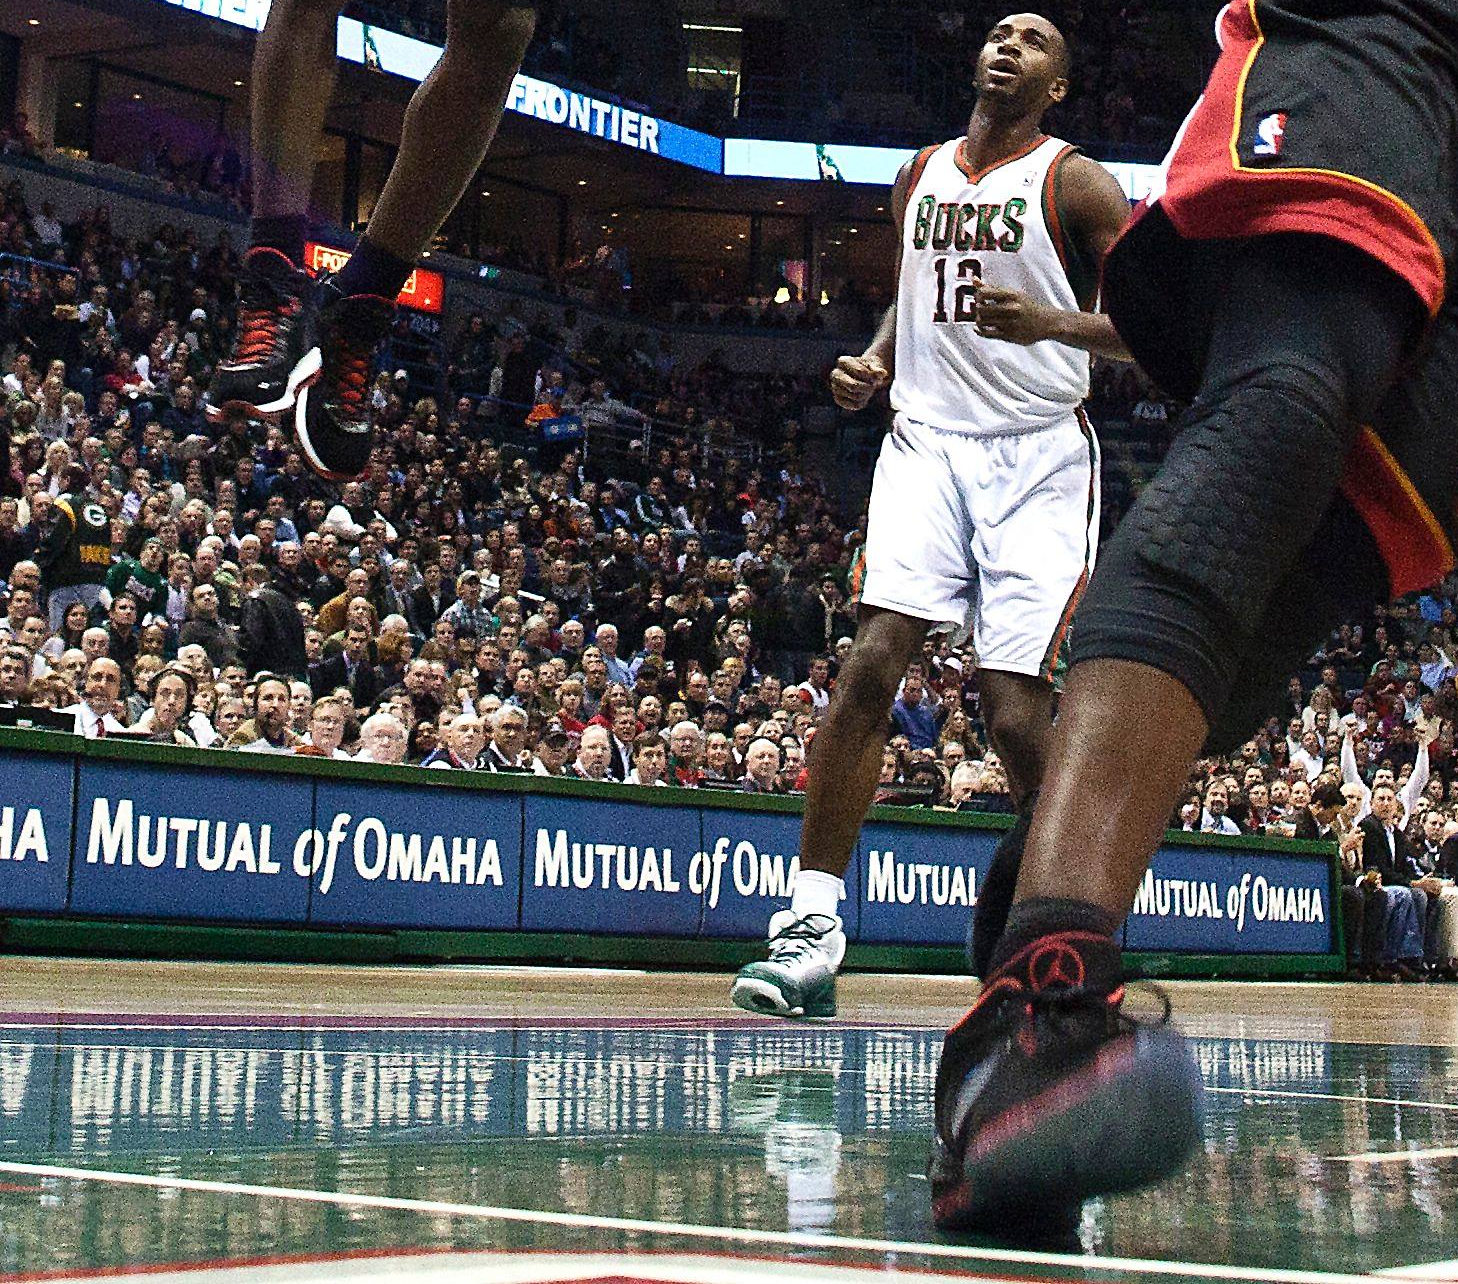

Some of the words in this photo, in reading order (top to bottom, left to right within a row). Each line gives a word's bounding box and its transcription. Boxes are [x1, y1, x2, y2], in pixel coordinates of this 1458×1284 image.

[505, 73, 660, 154] FRONTIER
[912, 193, 1028, 254] BUCKS
[931, 257, 984, 324] 12
[87, 797, 281, 874] MUTUAL
[293, 813, 351, 895] of
[353, 817, 503, 886] OMAHA
[533, 828, 680, 893] MUTUAL
[688, 837, 731, 909] of
[867, 850, 978, 906] MUTUAL
[1133, 868, 1223, 919] MUTUAL
[1226, 873, 1251, 932] of
[1252, 875, 1324, 923] OMAHA
